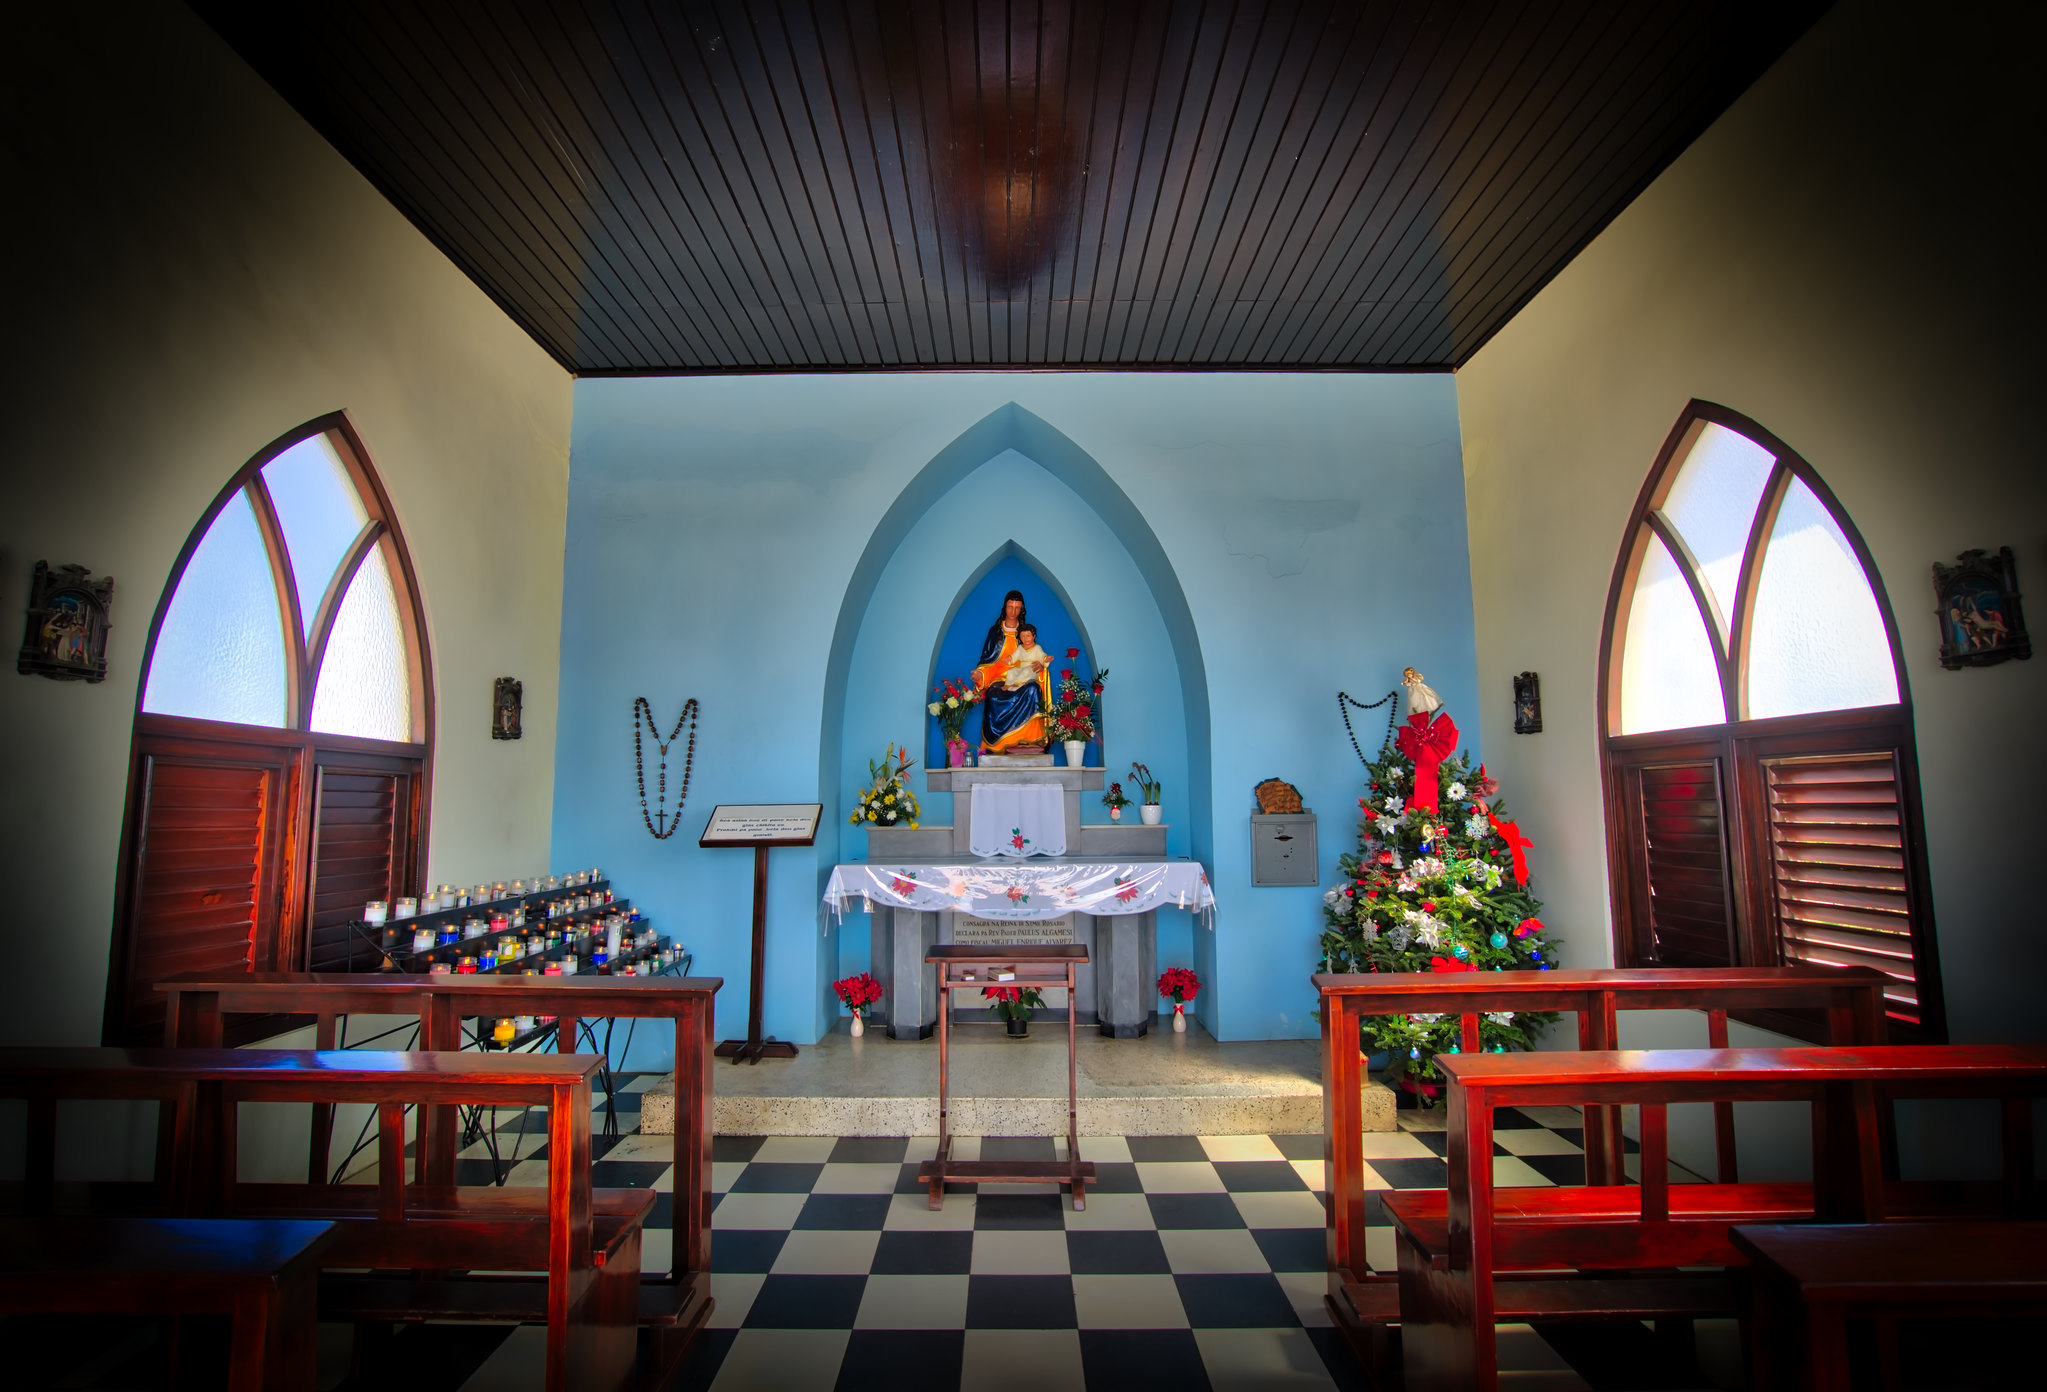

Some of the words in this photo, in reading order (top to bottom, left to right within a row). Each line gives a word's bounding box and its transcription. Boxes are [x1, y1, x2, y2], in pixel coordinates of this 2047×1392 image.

[1000, 919, 1017, 927] REINA
[1041, 919, 1066, 927] ROSARIO
[1041, 928, 1073, 936] ALGAMESI
